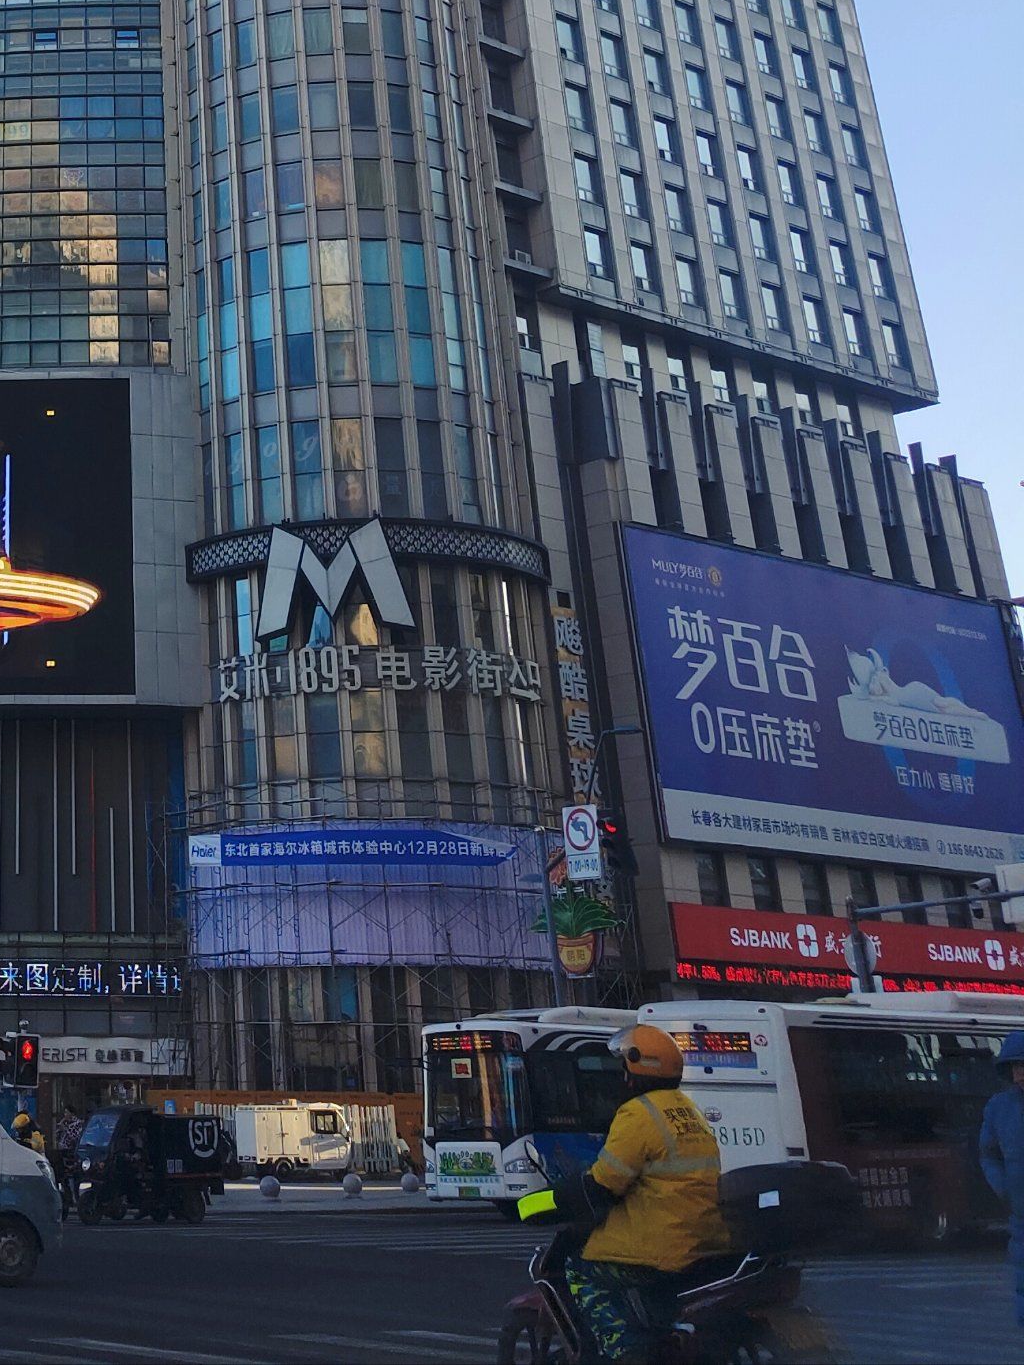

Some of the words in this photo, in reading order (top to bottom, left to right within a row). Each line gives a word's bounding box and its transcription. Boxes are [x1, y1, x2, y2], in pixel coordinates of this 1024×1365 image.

[666, 605, 818, 702] 梦百合
[730, 927, 793, 951] SJBANK
[927, 942, 982, 964] SJBANK
